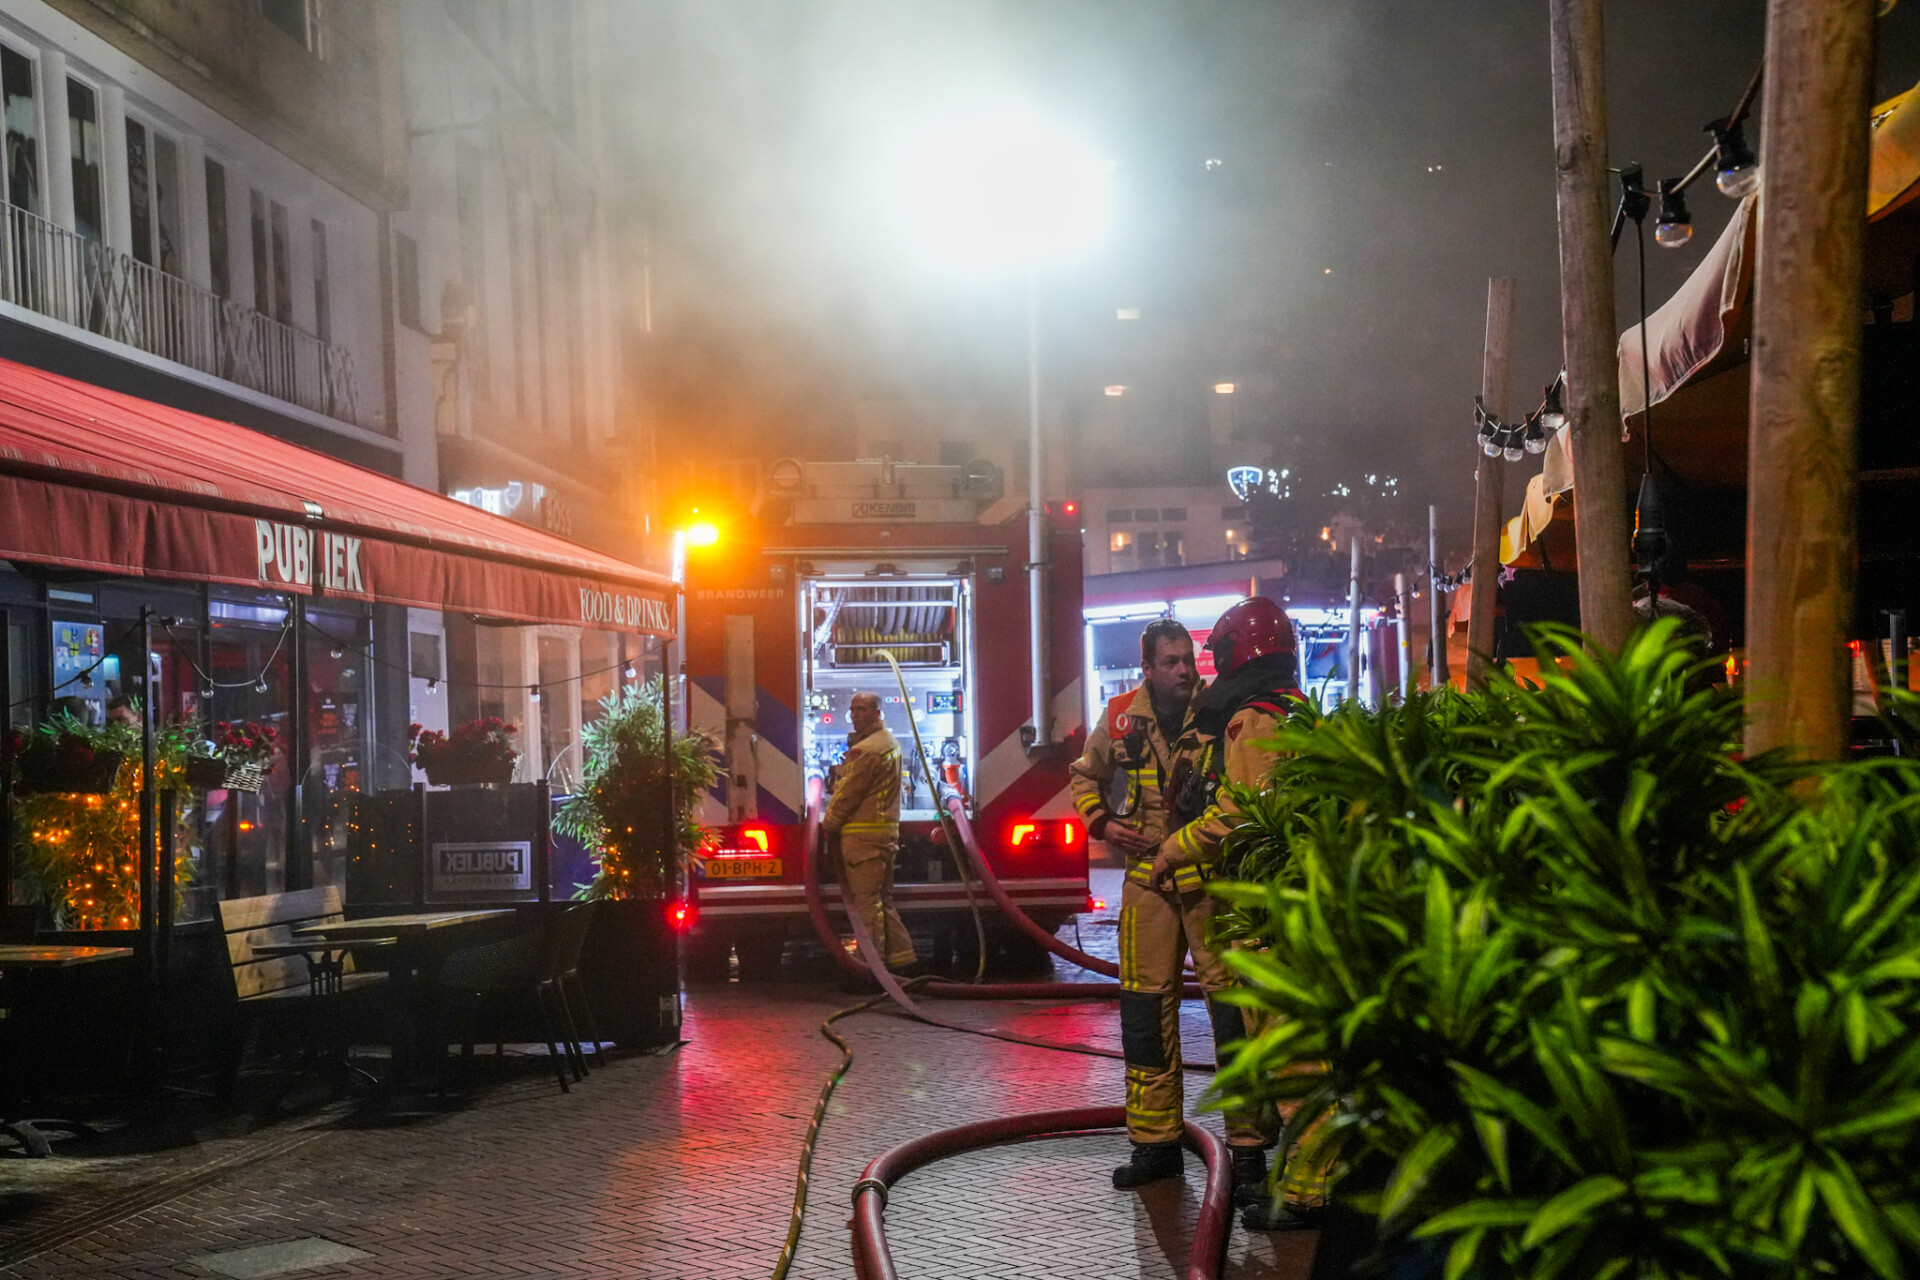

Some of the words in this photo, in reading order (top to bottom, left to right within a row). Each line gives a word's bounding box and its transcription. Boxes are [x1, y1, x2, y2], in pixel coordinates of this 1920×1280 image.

[696, 588, 785, 600] BRANDWEER
[579, 587, 613, 623] FOOD
[614, 593, 626, 625] &
[626, 595, 670, 631] DRINKS
